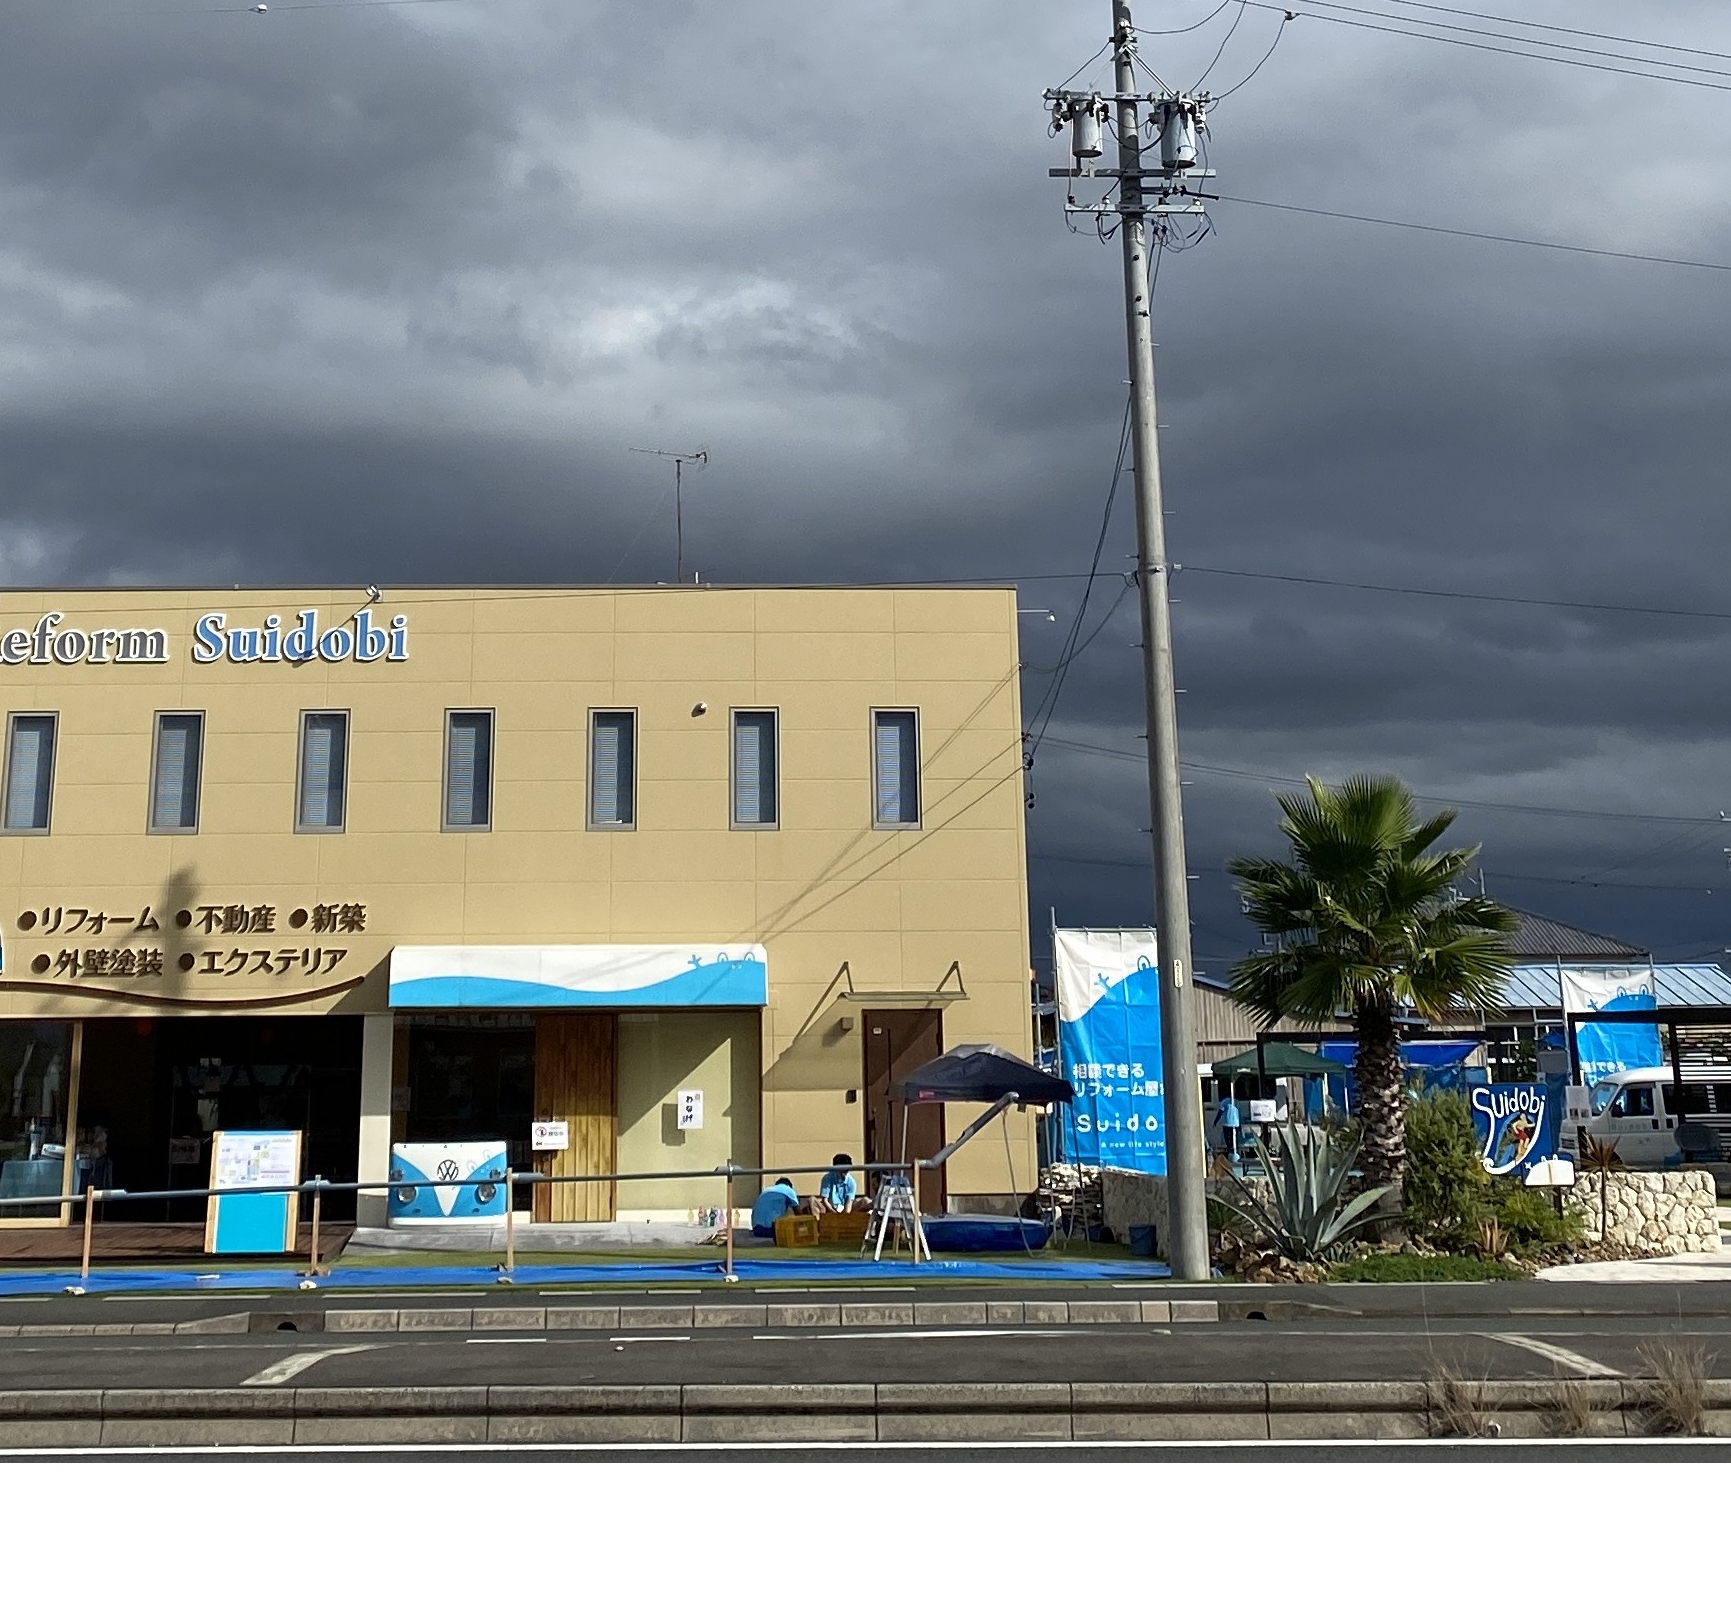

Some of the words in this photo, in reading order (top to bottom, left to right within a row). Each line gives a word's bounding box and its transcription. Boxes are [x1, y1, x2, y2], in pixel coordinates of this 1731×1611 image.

[193, 609, 409, 663] Suidobi
[40, 905, 161, 936] リフォーム
[194, 904, 277, 935] 不動産
[310, 902, 368, 934] 新築
[53, 948, 165, 979] 外壁塗装
[197, 946, 349, 976] エクステリア
